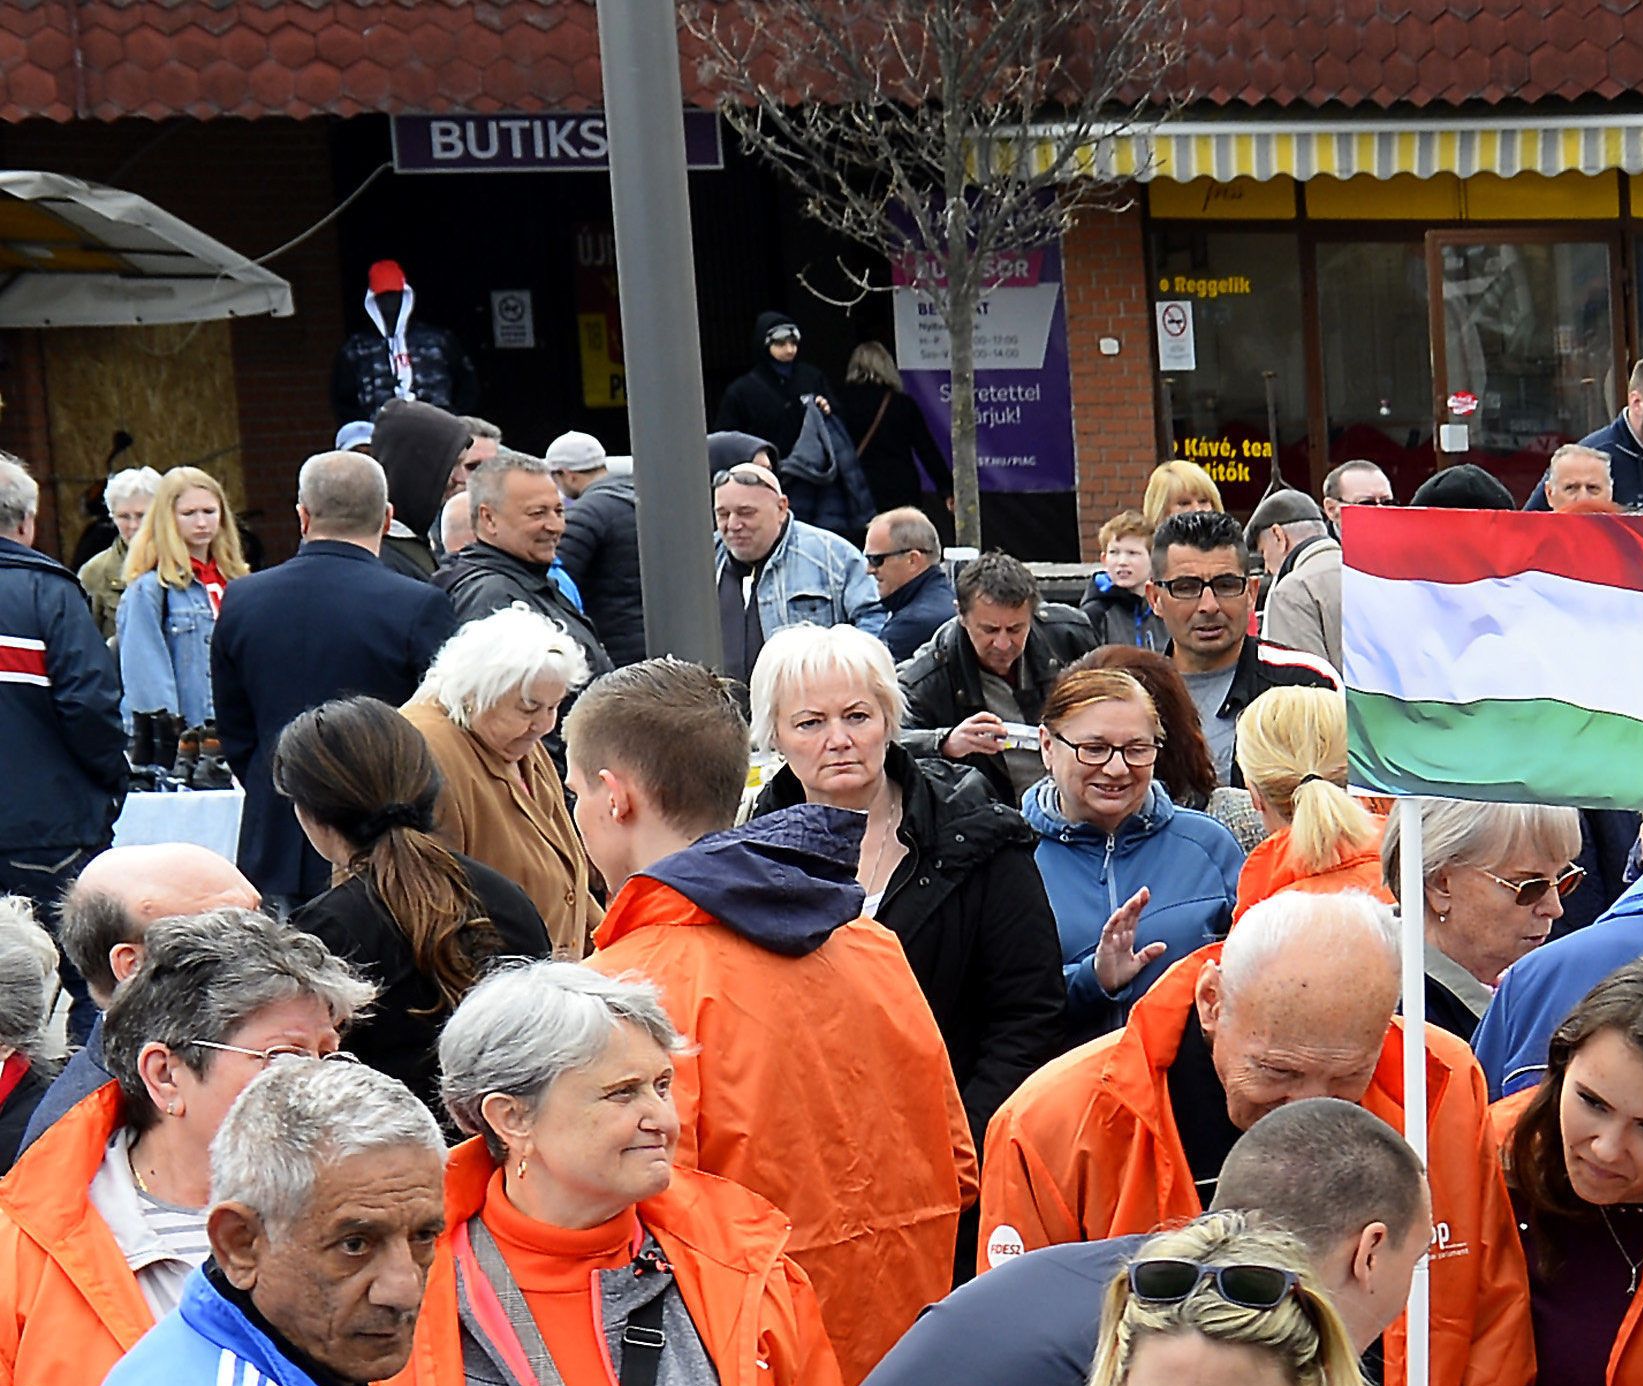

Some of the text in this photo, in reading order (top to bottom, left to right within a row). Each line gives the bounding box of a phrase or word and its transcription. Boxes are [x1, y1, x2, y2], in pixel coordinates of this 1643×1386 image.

[430, 119, 608, 160] BUTIKS
[1174, 276, 1251, 298] Reggelik
[1184, 436, 1273, 459] Kávé, tea
